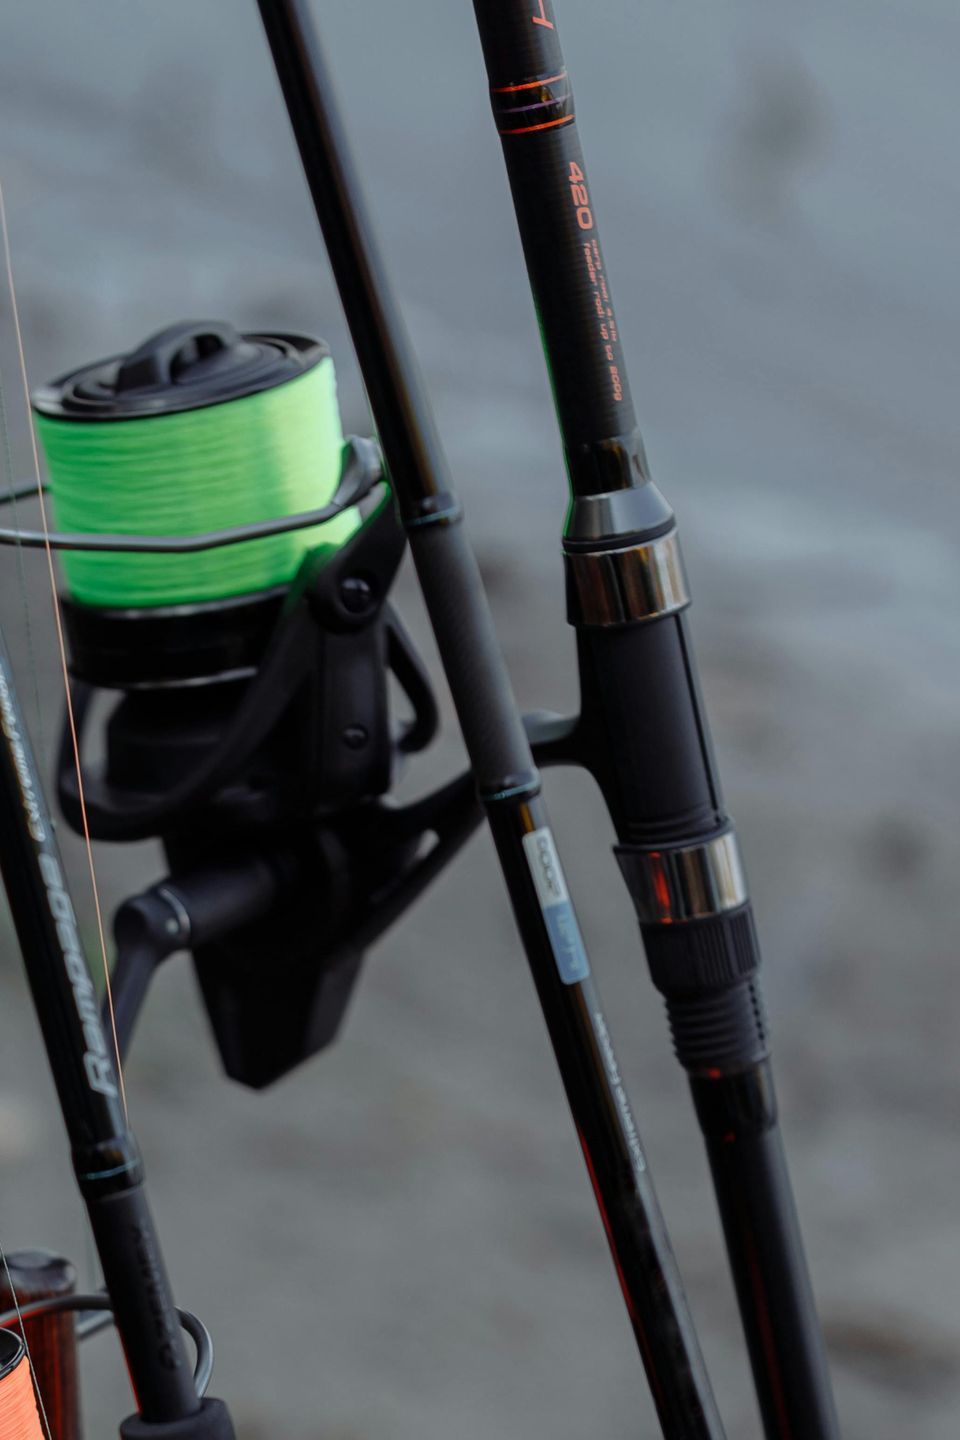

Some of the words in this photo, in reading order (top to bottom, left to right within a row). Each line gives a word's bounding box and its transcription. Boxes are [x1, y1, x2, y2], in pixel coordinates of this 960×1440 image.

[568, 161, 594, 230] 420
[583, 243, 598, 286] feeder
[600, 323, 609, 341] up
[606, 344, 614, 361] to
[38, 852, 118, 1098] Rampage
